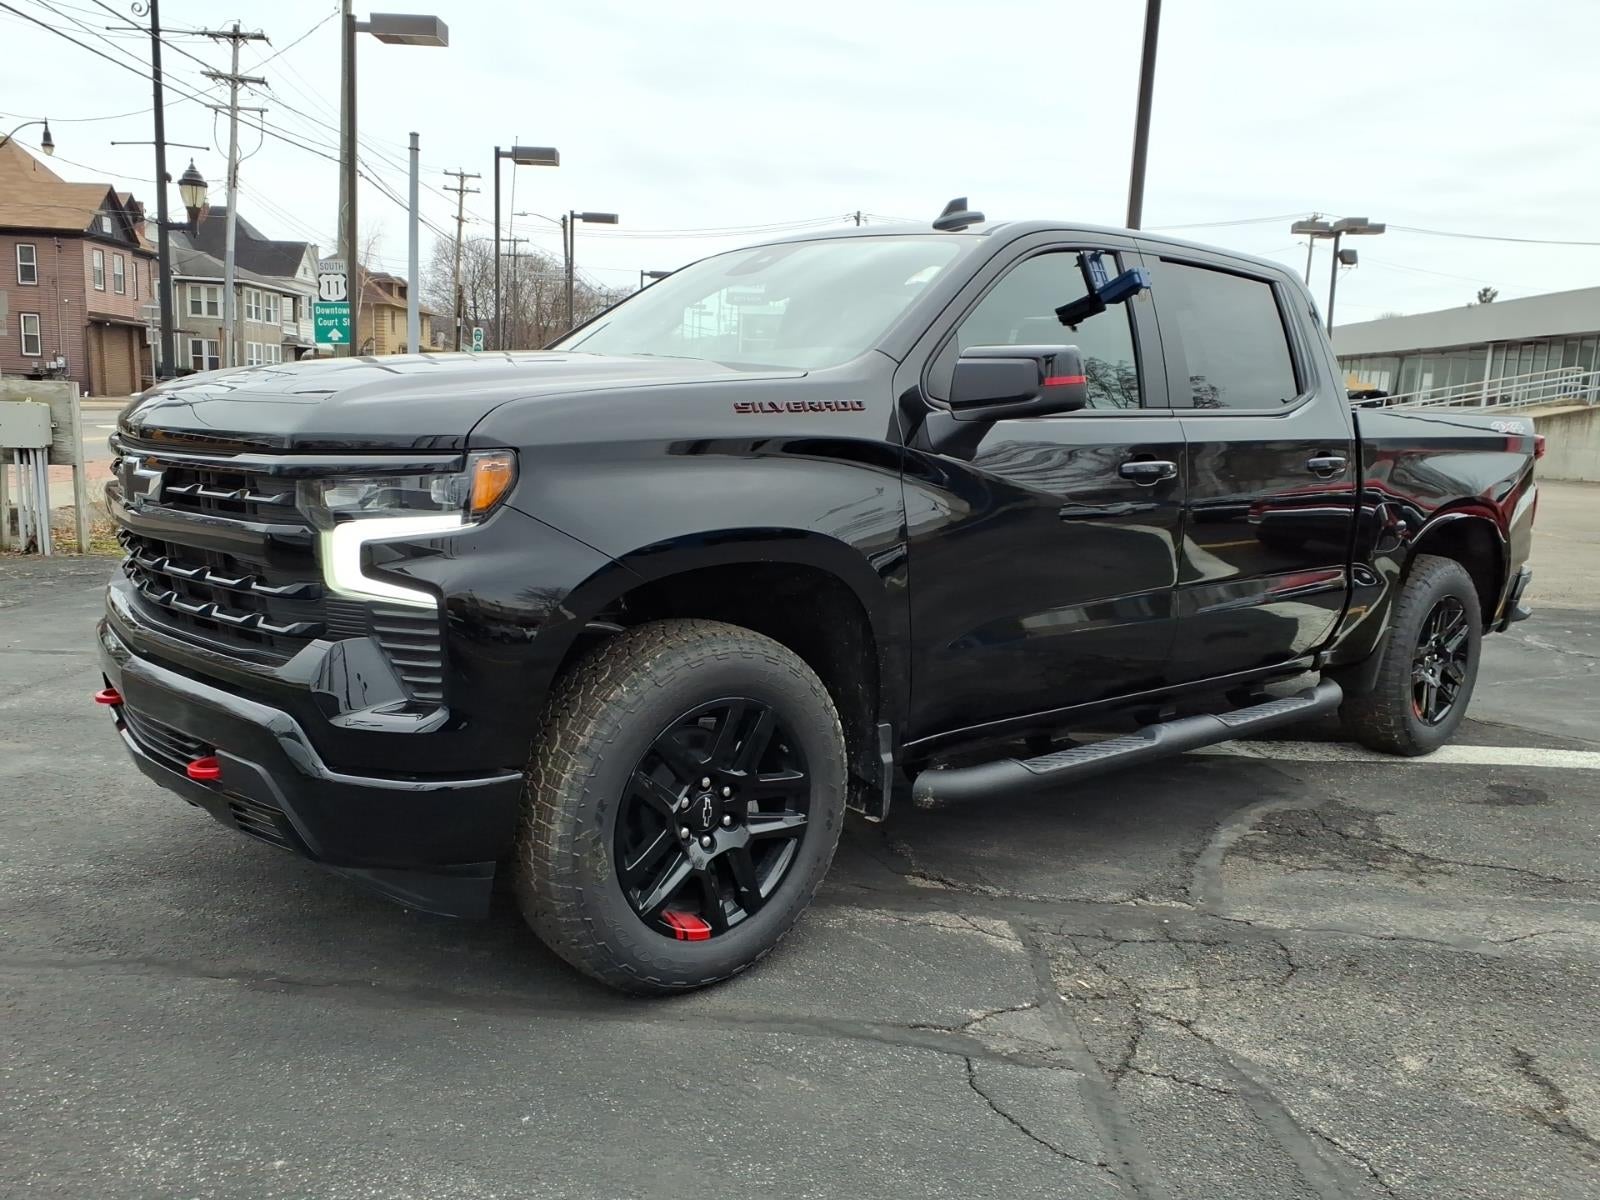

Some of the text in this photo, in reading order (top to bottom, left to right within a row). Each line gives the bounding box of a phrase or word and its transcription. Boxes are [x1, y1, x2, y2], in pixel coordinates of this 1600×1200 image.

[319, 262, 344, 271] SOUTH
[327, 281, 340, 295] 11
[317, 317, 338, 326] Court
[734, 400, 866, 413] SILVERADO
